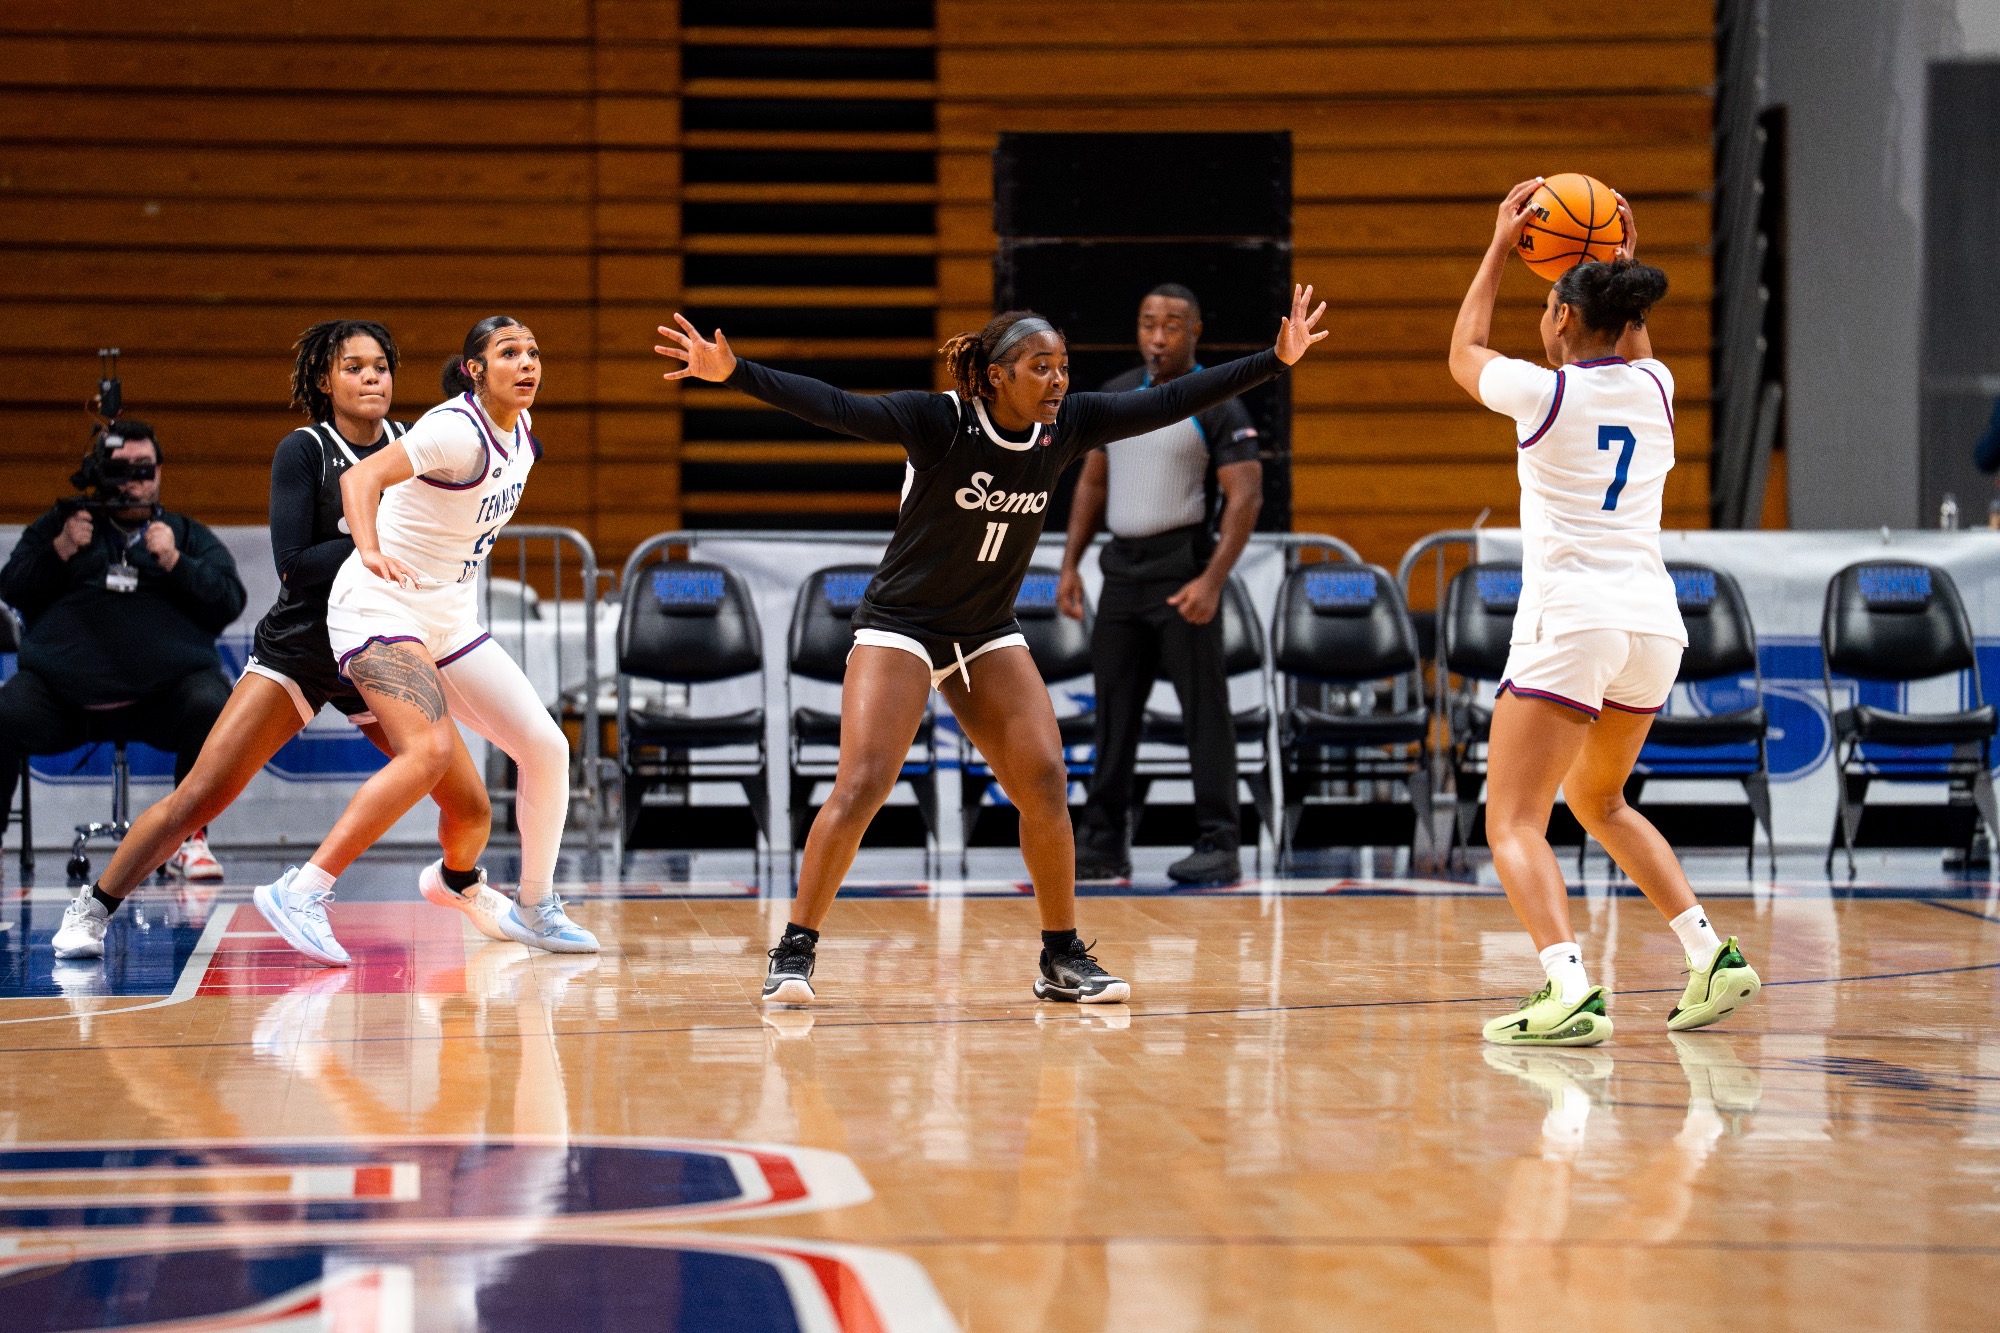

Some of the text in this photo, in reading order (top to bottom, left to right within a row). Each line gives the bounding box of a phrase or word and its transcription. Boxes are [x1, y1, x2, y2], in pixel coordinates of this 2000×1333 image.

[1597, 425, 1637, 511] 7
[955, 471, 1048, 515] Semo
[977, 521, 1010, 562] 11
